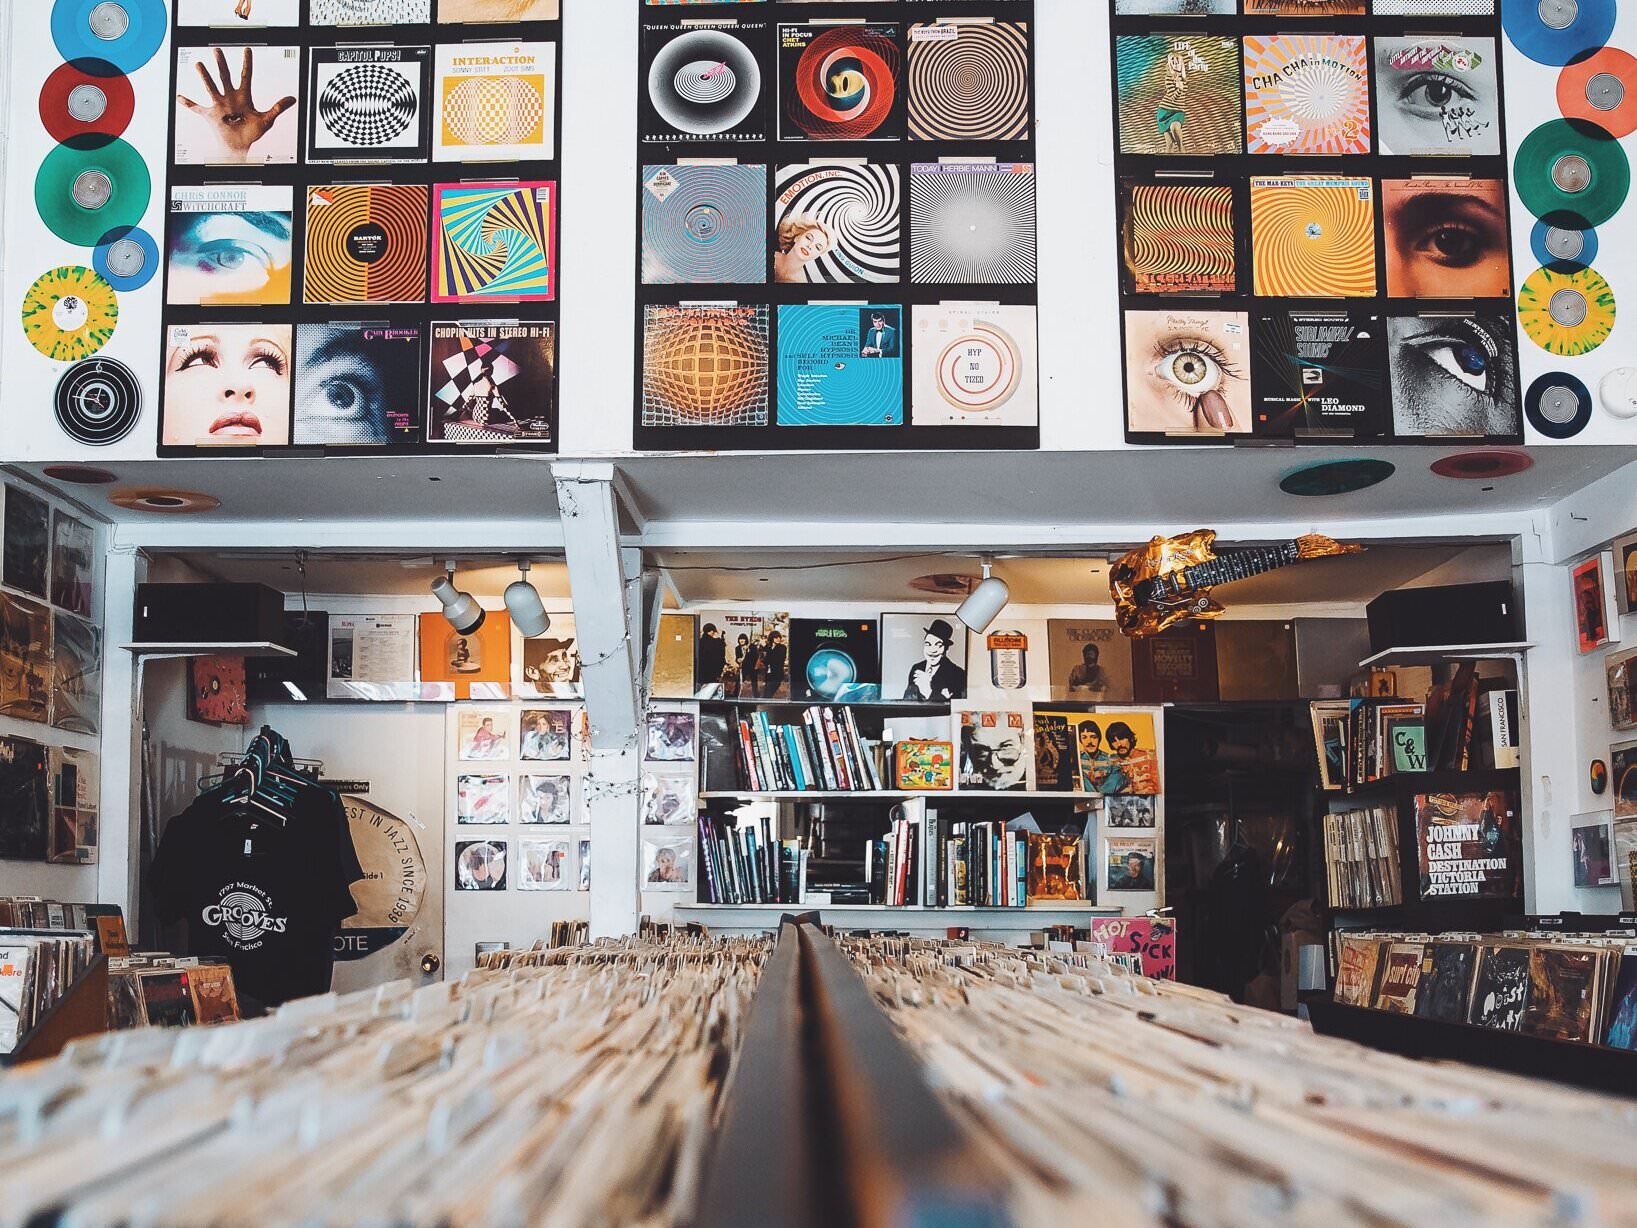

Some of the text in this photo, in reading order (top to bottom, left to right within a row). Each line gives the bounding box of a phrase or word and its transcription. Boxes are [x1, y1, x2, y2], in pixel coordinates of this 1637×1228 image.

[338, 50, 401, 61] CAPITOL POPS!
[452, 56, 536, 66] INTERACTION
[1253, 58, 1362, 90] CHA CHA in MOTION
[208, 191, 246, 200] CONNOR
[835, 249, 864, 275] KING GUION
[435, 327, 550, 338] CHOPIN HITS IN STEREO HI-FI
[967, 349, 982, 357] HYP
[969, 362, 980, 370] NO
[965, 376, 984, 384] TIZED
[1497, 697, 1508, 747] SAN FRANCISCO
[353, 784, 369, 792] Only
[370, 815, 384, 828] IN
[384, 826, 409, 854] JAZZ
[1427, 824, 1480, 842] JOHNNY
[1427, 843, 1462, 860] CASH
[1428, 858, 1507, 872] DESTINATION
[402, 857, 415, 894] SINCE
[1429, 870, 1486, 883] VICTORIA
[218, 883, 234, 896] 1797
[237, 882, 266, 897] Market
[1429, 882, 1479, 895] STATION
[388, 897, 410, 923] 1939
[202, 904, 287, 933] GROOVES
[1093, 921, 1130, 942] HOT
[222, 932, 233, 946] San
[1389, 964, 1407, 984] surf
[1406, 965, 1421, 987] city
